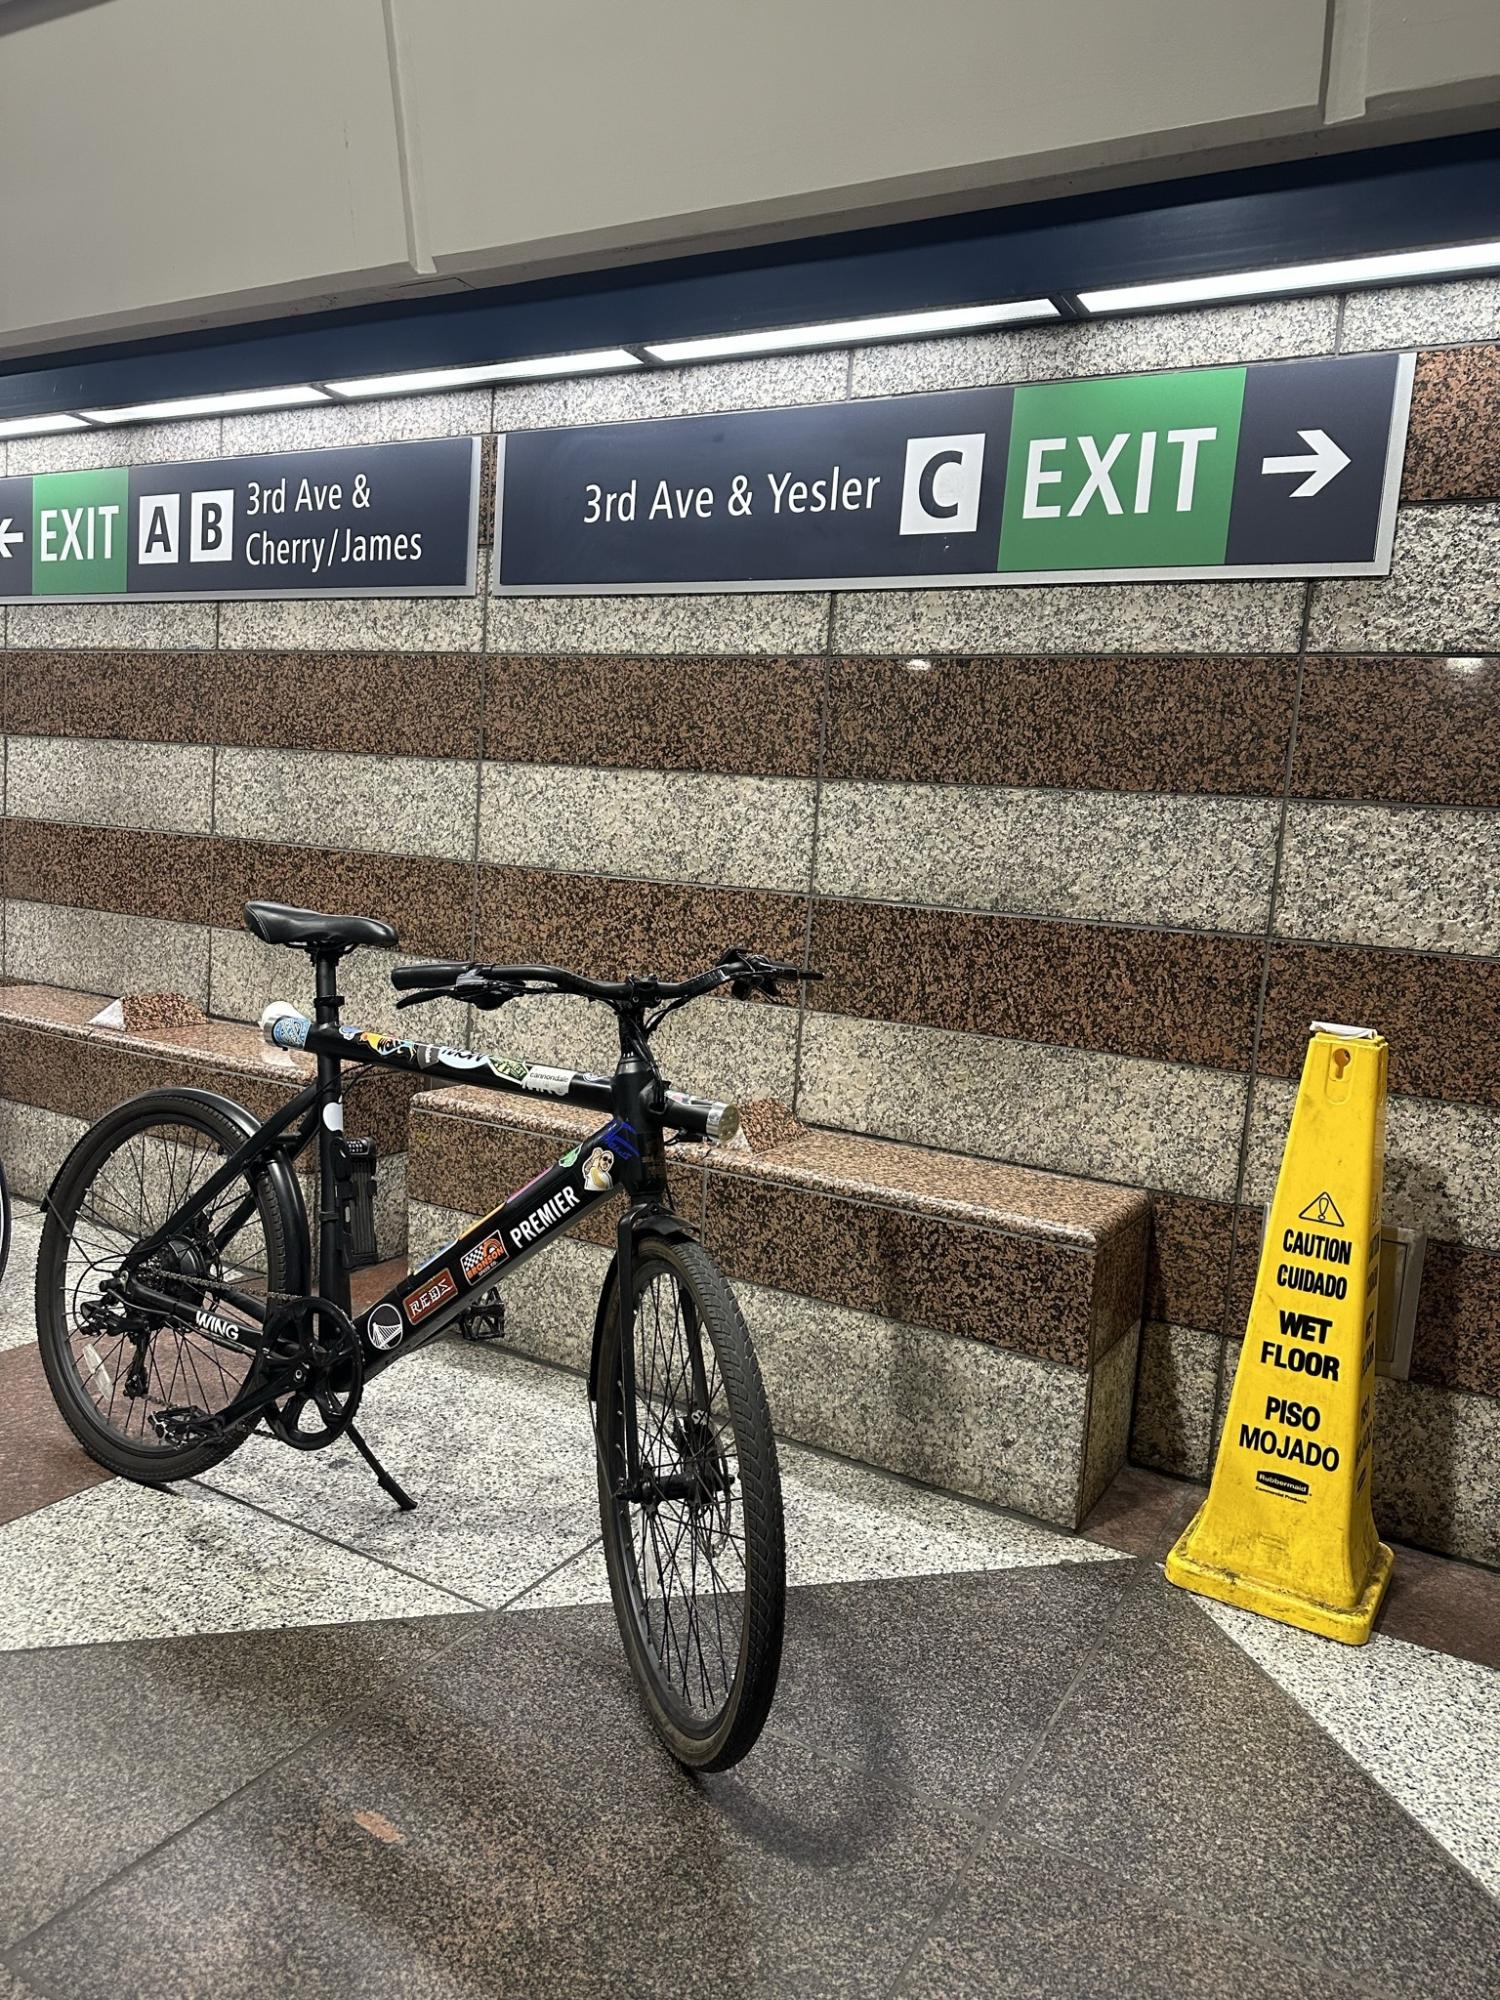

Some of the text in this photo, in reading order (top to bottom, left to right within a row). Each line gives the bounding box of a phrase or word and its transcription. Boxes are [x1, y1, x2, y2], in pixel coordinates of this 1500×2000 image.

[246, 473, 371, 516] 3rd Ave &
[583, 466, 881, 524] 3rd Ave & Yesler
[918, 450, 964, 519] C
[1022, 427, 1218, 520] EXIT
[40, 505, 119, 562] EXIT
[144, 506, 172, 553] A
[201, 502, 223, 551] B
[245, 528, 422, 573] Cherry/James
[509, 1185, 581, 1248] PREMIER
[466, 1245, 505, 1278] BRONSON
[1283, 1229, 1352, 1265] CAUTION
[1276, 1264, 1348, 1300] CUIDADO
[196, 1310, 239, 1341] WING
[1279, 1310, 1333, 1344] WET
[1260, 1341, 1340, 1381] FLOOR
[1265, 1396, 1321, 1432] PISO
[1238, 1424, 1340, 1472] MOJADO
[1259, 1474, 1307, 1492] Rubbermaid
